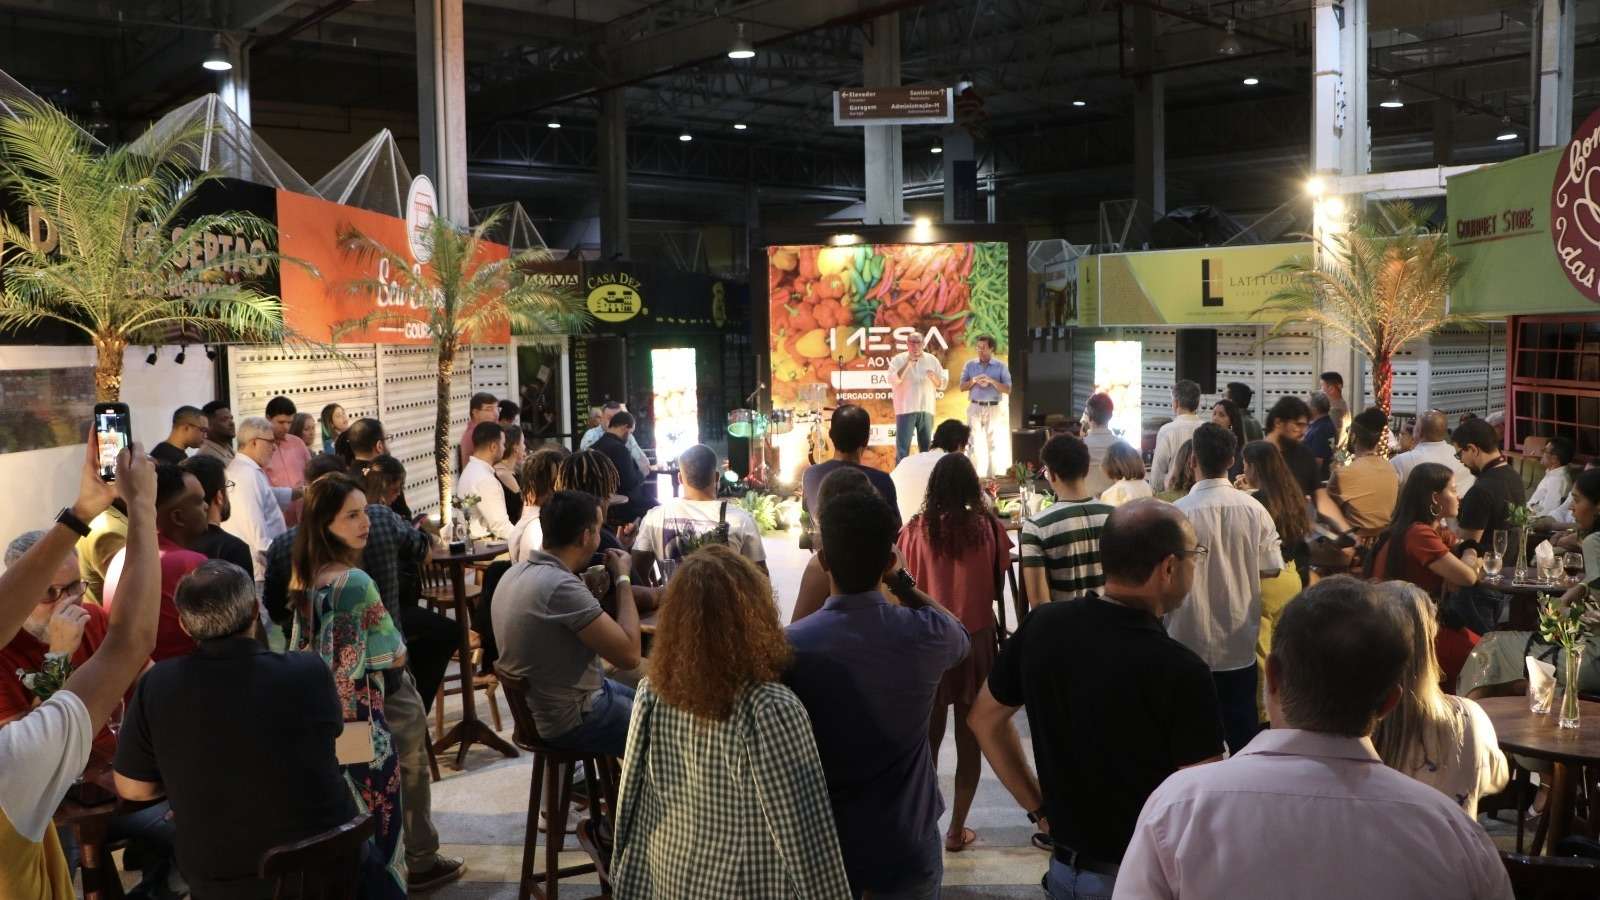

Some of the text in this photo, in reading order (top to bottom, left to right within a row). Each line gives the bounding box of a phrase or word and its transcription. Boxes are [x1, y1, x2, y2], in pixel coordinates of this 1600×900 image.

[1456, 208, 1535, 239] GOURMET STORE
[587, 273, 617, 289] CASA
[867, 356, 885, 368] AO
[836, 392, 874, 400] MERCADO
[875, 392, 887, 400] DO
